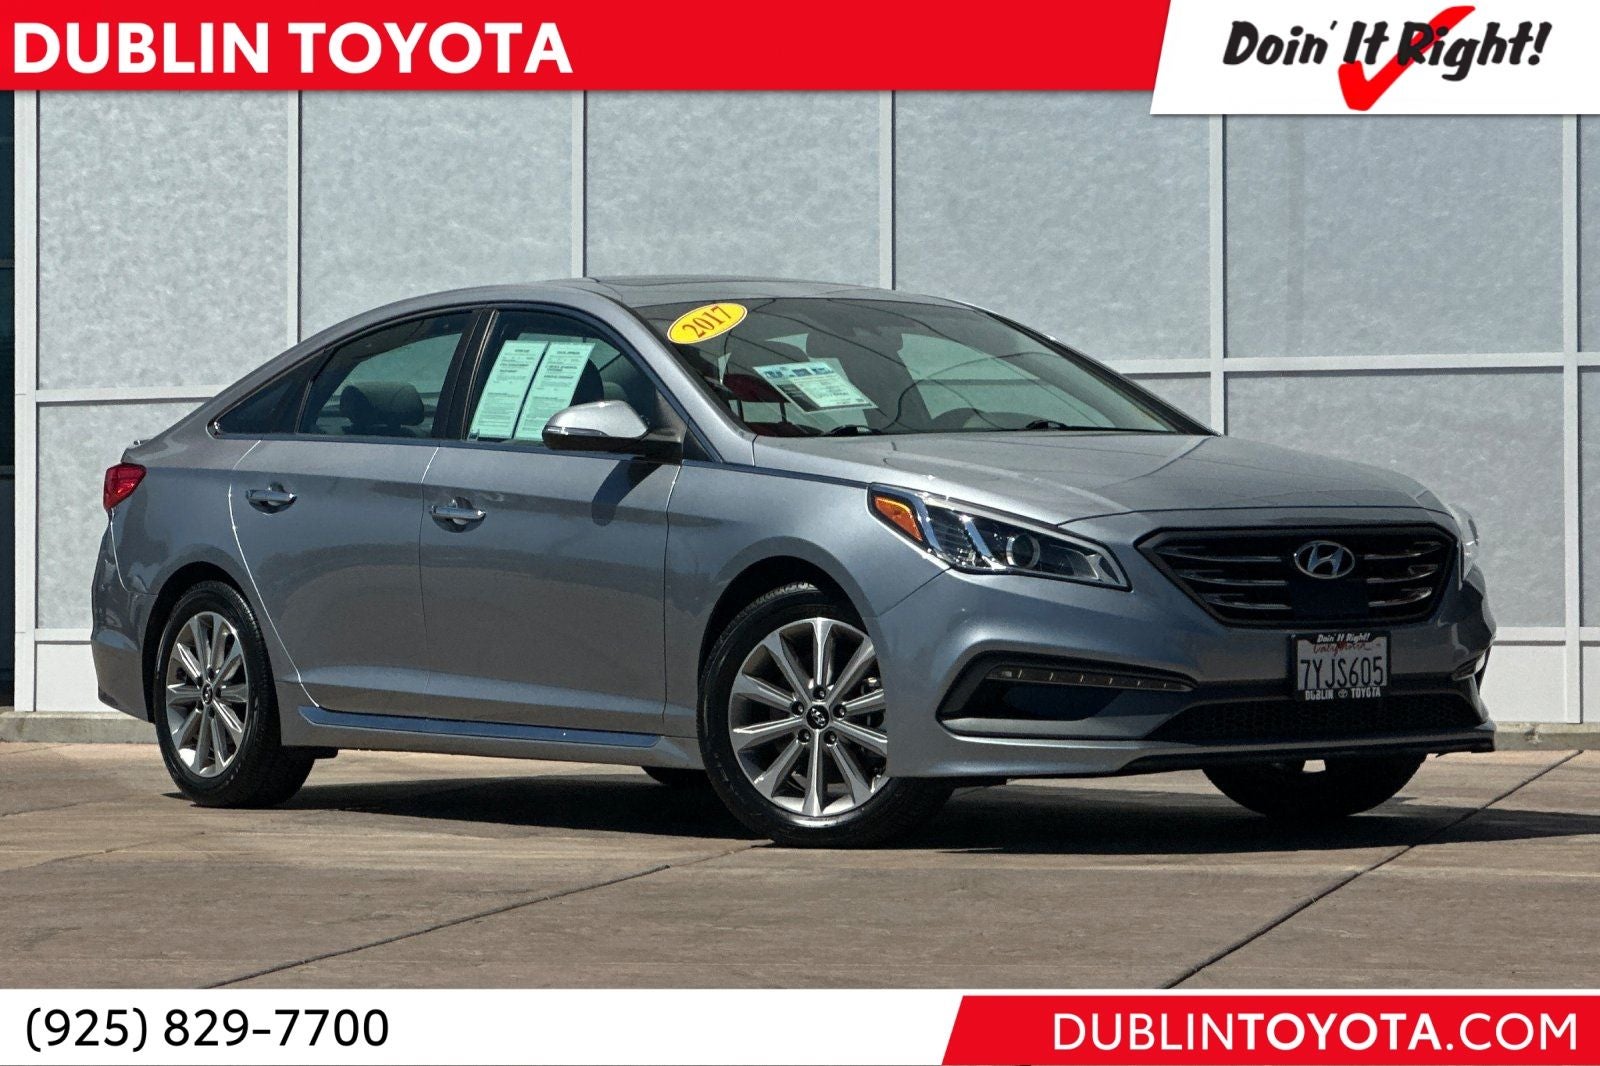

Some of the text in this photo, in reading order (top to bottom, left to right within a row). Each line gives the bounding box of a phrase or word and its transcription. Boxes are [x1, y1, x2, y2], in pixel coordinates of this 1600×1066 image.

[682, 305, 732, 338] 2017
[1300, 655, 1383, 690] 7YJS605
[1305, 687, 1381, 700] DUBLIN TOYOTA
